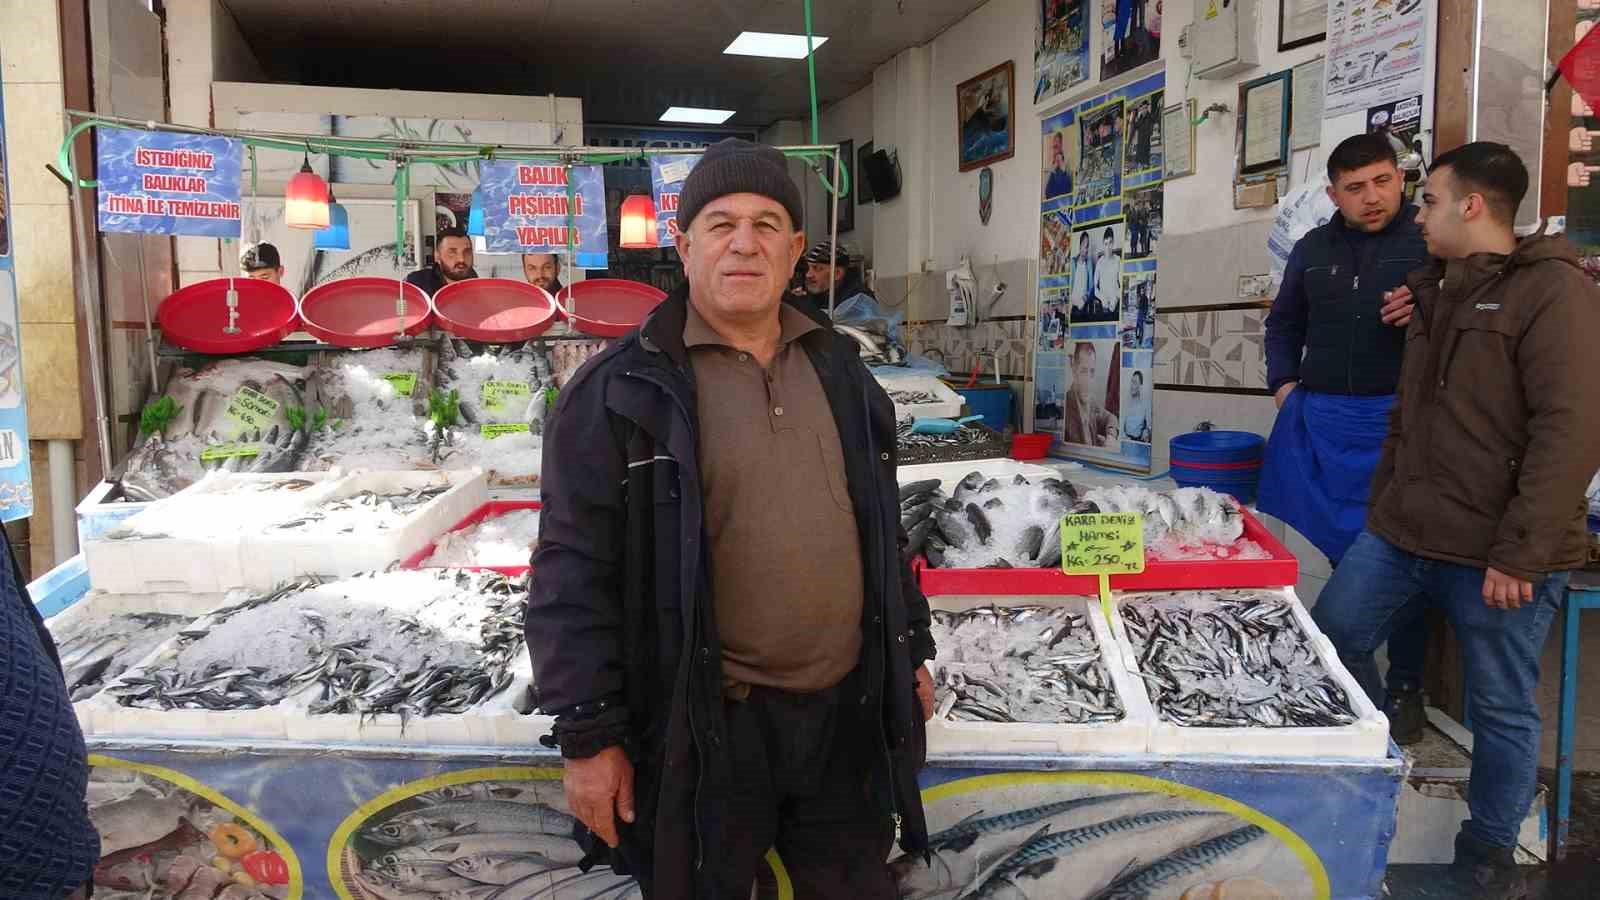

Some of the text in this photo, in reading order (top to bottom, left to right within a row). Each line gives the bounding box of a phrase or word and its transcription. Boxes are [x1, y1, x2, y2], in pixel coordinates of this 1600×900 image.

[136, 146, 215, 170] İSTEDİĞİNİZ
[143, 173, 207, 194] BALIKLAR
[518, 165, 569, 186] BALIK
[107, 193, 240, 220] İTİNA İLE TEMİZLENİR
[1065, 515, 1097, 526] KARA
